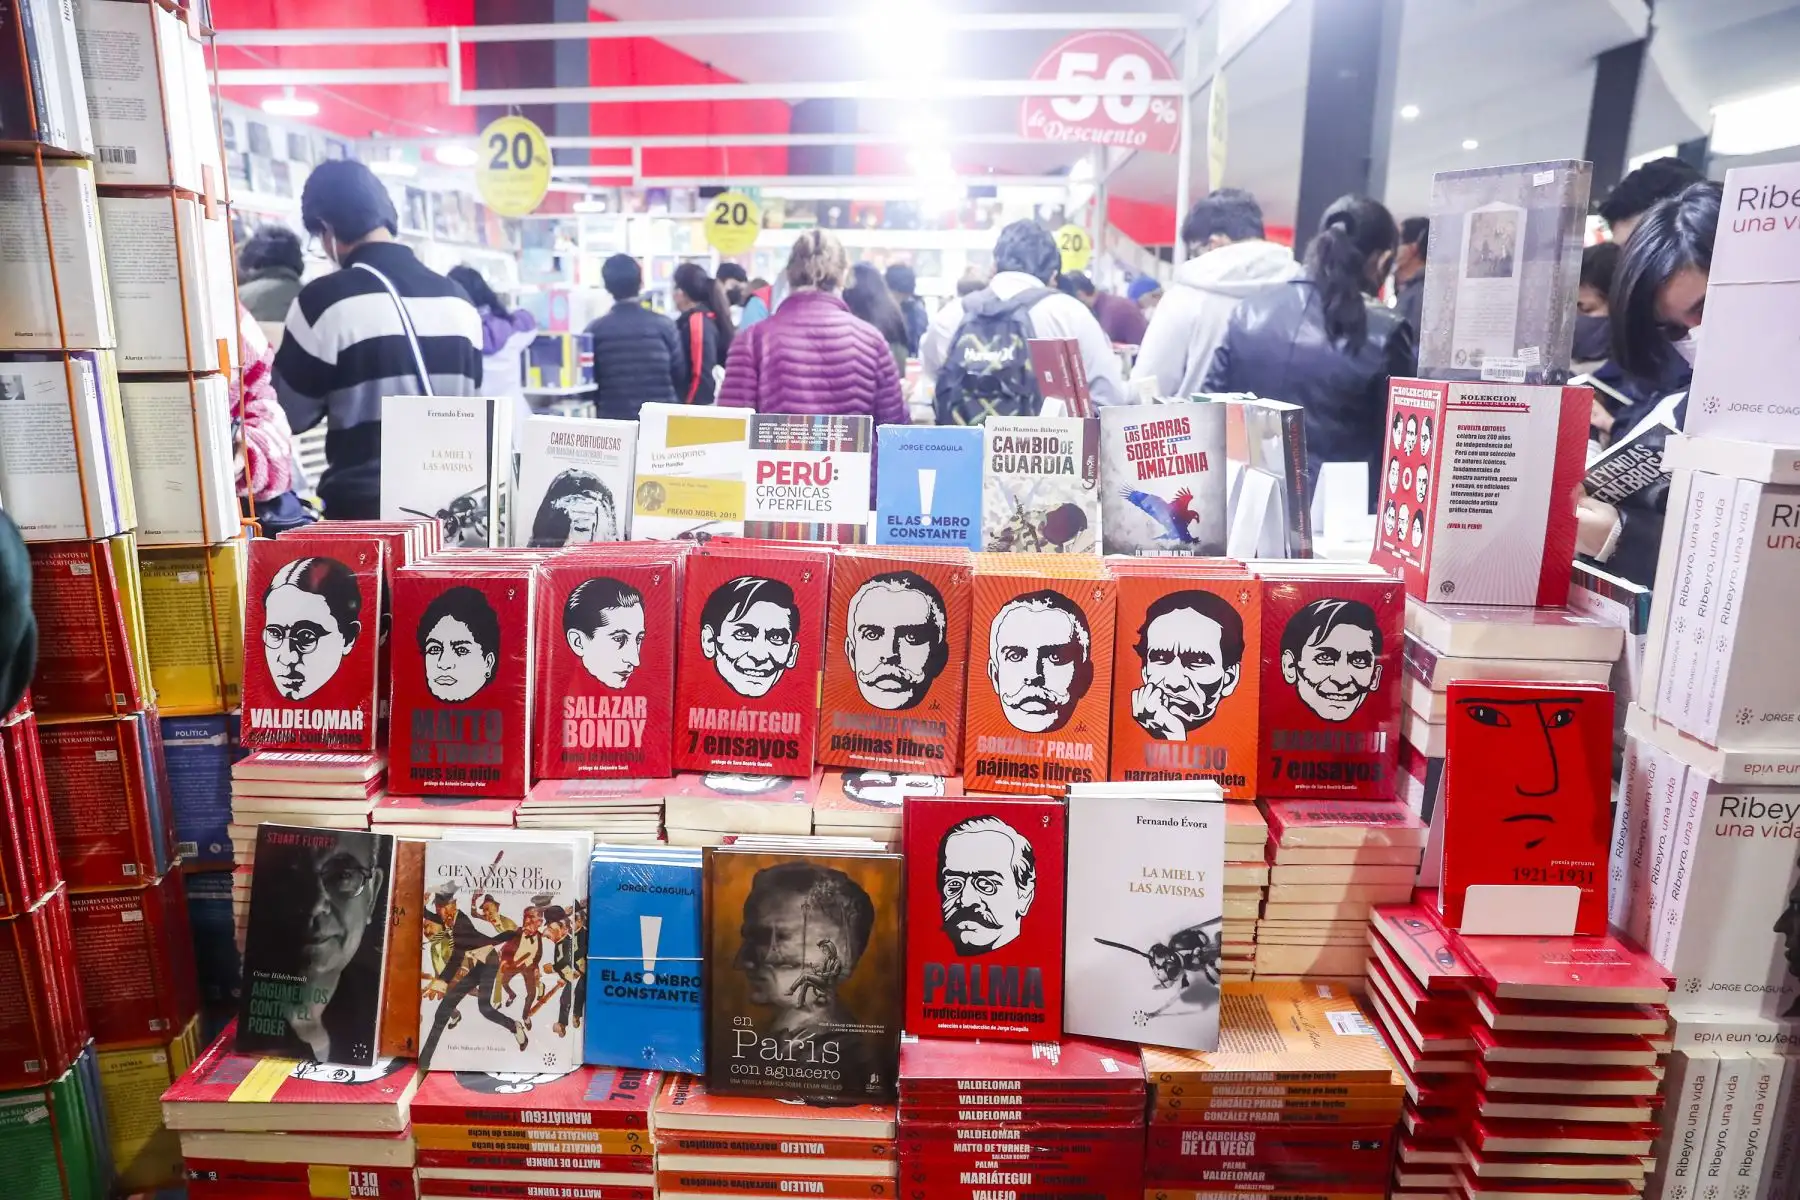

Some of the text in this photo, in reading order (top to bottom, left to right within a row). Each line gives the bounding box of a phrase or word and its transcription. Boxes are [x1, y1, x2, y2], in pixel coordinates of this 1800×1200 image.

[1043, 120, 1148, 145] Descuento
[488, 132, 533, 169] 20
[715, 202, 747, 226] 20
[1732, 216, 1775, 234] una
[1061, 233, 1083, 252] 20
[1125, 416, 1191, 443] LAS GARRAS
[550, 431, 622, 451] CARTAS PORTUGUESAS
[925, 444, 963, 452] COAGUILA
[992, 436, 1074, 455] CAMBIO DE
[431, 449, 473, 459] LA MIEL Y
[651, 449, 706, 461] Los avispones
[1126, 440, 1178, 461] SOBRE LA
[423, 462, 473, 472] LAS AVISPAS
[756, 456, 839, 486] PERÚ:
[991, 455, 1075, 475] GUARDIA
[1137, 451, 1209, 480] AMAZONIA
[1587, 444, 1654, 488] LEYENDAS
[756, 498, 832, 512] Y PERFILES
[667, 508, 693, 516] PREMIO
[720, 511, 737, 519] 2019
[889, 527, 967, 540] CONSTANTE
[1679, 490, 1705, 607] Ribeyro, una vida
[1697, 498, 1726, 618] Ribeyro, una vida
[563, 695, 647, 719] SALAZAR
[250, 708, 364, 730] VALDELOMAR
[688, 706, 801, 734] MARIÁTEGUI
[1760, 712, 1794, 722] JORGE
[175, 729, 208, 738] POLÍTICA
[411, 709, 503, 742] MATTO
[563, 718, 647, 748] BONDY
[688, 730, 799, 760] 7 ensayos
[830, 732, 893, 754] pájinas
[896, 737, 945, 760] libres
[254, 752, 373, 762] VALDELOMAR
[1144, 743, 1228, 771] VALLEJO
[410, 765, 501, 781] aves sin nido
[976, 757, 1092, 783] pájinas libres
[1271, 756, 1385, 783] 7 ensayos
[1136, 815, 1208, 829] Fernando Évora
[1715, 822, 1754, 838] una
[1651, 777, 1676, 885] Ribeyro, una vida
[266, 832, 336, 849] STUART FLORES
[1671, 790, 1700, 902] Ribeyro, una vida
[1550, 859, 1570, 867] poesía
[1143, 866, 1206, 882] LA MIEL Y
[1512, 867, 1594, 884] 1921-1931
[616, 883, 696, 896] JORGE COAGUILA
[1129, 882, 1205, 898] LAS AVISPAS
[601, 968, 620, 981] EL
[922, 962, 1046, 1009] PALMA
[1707, 982, 1794, 994] JORGE COAGUILA
[603, 985, 700, 1004] CONSTANTE
[733, 1015, 753, 1027] en
[923, 1007, 1046, 1024] tradiciones peruanas
[248, 1016, 285, 1037] PODER
[731, 1028, 840, 1064] París
[730, 1064, 841, 1080] con aguacero
[957, 1080, 1021, 1090] VALDELOMAR
[958, 1095, 1023, 1105] VALDELOMAR
[520, 1110, 592, 1125] MARIÁTEGUI
[958, 1110, 1022, 1120] VALDELOMAR
[1204, 1110, 1247, 1121] GONZÁLEZ
[1249, 1112, 1280, 1122] PRADA
[468, 1129, 491, 1138] lucha
[503, 1130, 526, 1138] horas
[1675, 1075, 1705, 1177] Ribeyro, una vida
[1708, 1075, 1739, 1177] Ribeyro, una vida
[1738, 1075, 1770, 1177] Ribeyro, una vida
[527, 1130, 556, 1140] PRADA
[558, 1131, 599, 1141] GONZÁLEZ
[957, 1129, 1021, 1140] VALDELOMAR
[1182, 1130, 1256, 1141] INCA GARCILASO
[472, 1141, 603, 1153] GONZÁLEZ PRADA horas de lucha
[953, 1143, 1030, 1153] MATTO DE TURNER
[1181, 1140, 1255, 1157] DE LA VEGA
[526, 1157, 601, 1168] MATTO DE TURNER
[975, 1160, 999, 1169] PALMA
[1222, 1161, 1247, 1170] PALMA
[960, 1170, 1032, 1185] MARIÁTEGUI
[1202, 1170, 1266, 1181] VALDELOMAR
[357, 1186, 379, 1197] INCA
[527, 1186, 602, 1198] MATTO DE TURNER
[730, 1180, 777, 1190] narrativa
[780, 1180, 825, 1193] VALLEJO
[972, 1189, 1017, 1200] VALLEJO
